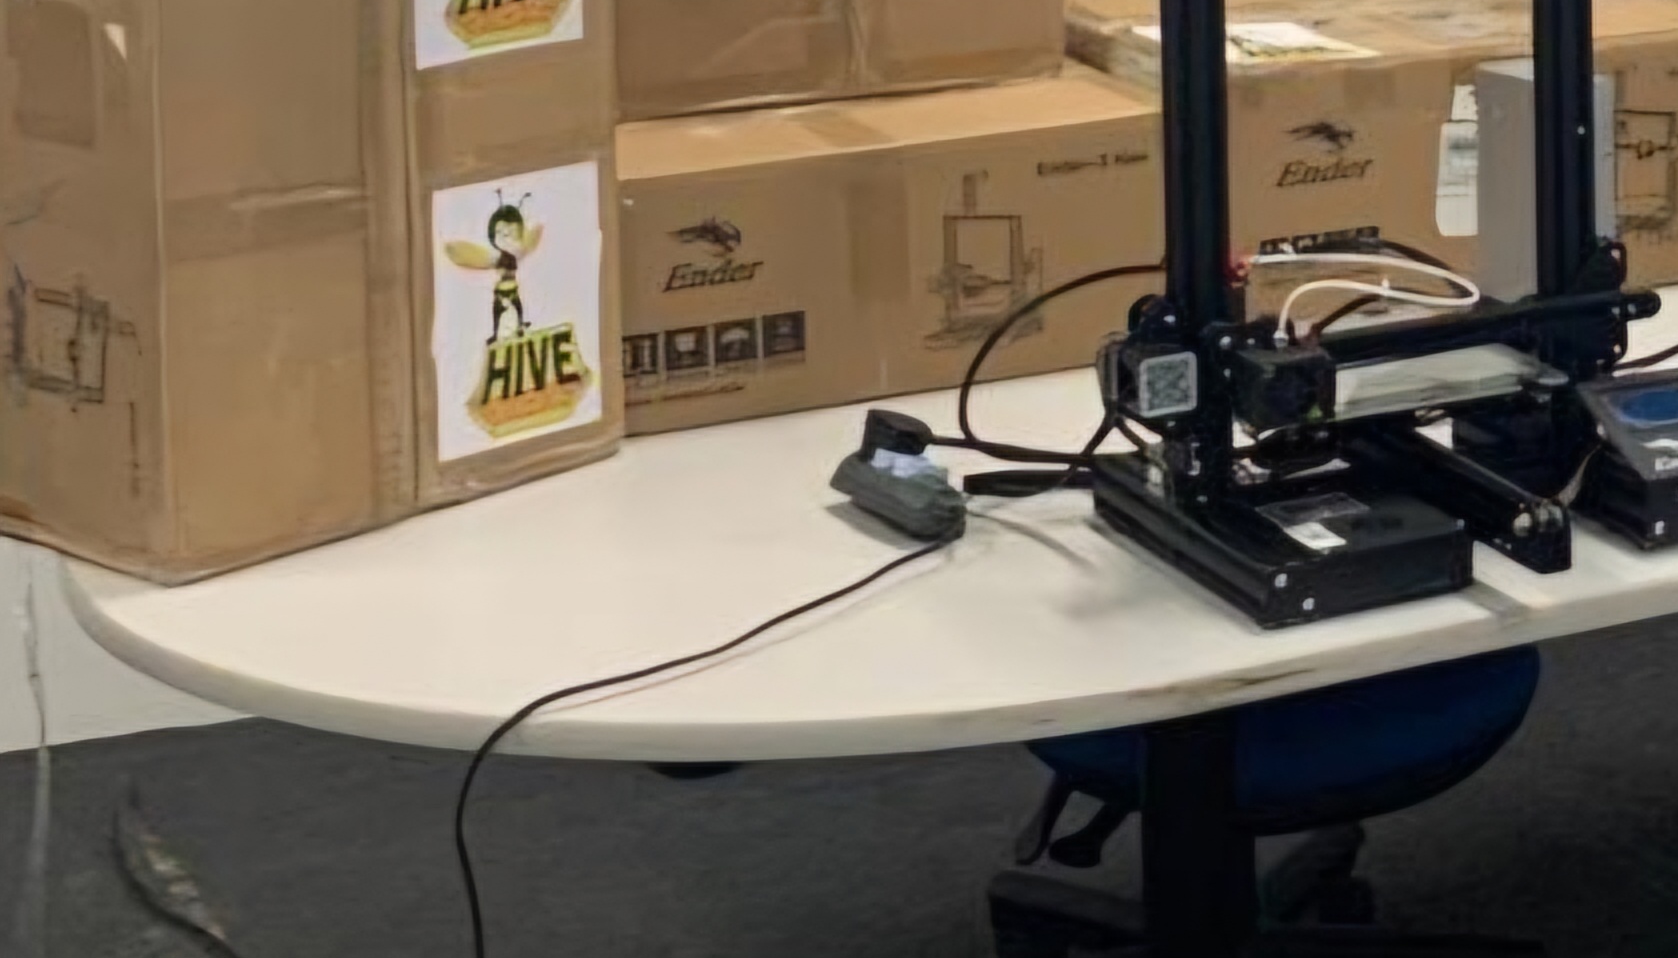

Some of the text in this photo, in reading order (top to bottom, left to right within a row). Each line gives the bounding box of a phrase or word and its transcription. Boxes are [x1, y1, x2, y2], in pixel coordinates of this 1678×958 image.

[1275, 158, 1374, 187] Ender
[662, 258, 764, 293] Ender
[481, 329, 581, 405] HIVE
